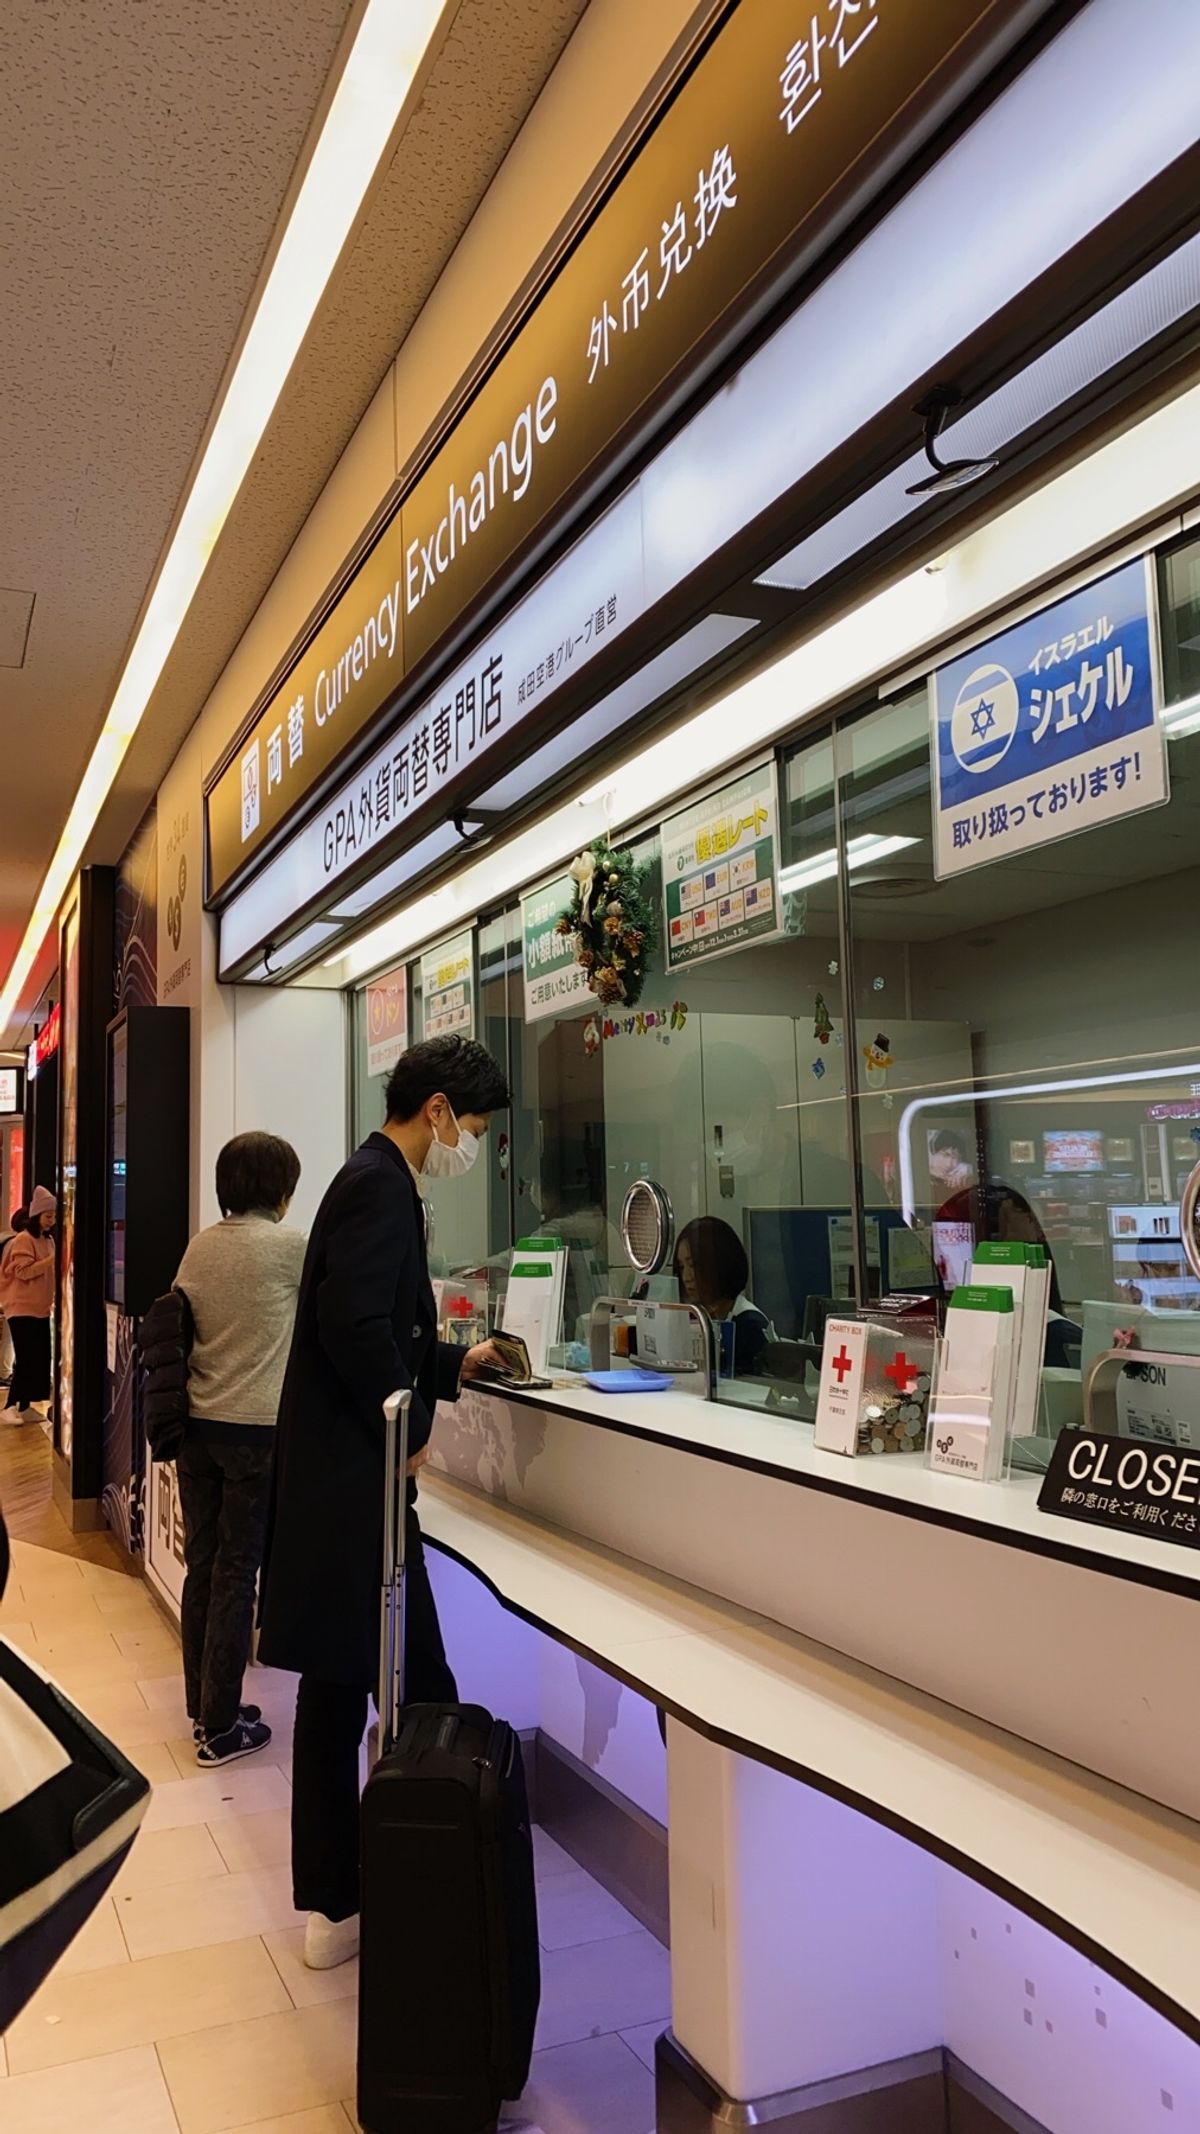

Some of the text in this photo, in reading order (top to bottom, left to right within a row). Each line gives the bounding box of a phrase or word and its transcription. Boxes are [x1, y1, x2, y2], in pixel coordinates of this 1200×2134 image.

[267, 695, 304, 795] 両替
[314, 580, 399, 727] Currency
[407, 376, 557, 615] Exchange
[586, 144, 737, 384] 外币兑换
[516, 593, 618, 705] 成田空港グループ直営
[1028, 615, 1115, 676] イスラエル
[829, 1323, 862, 1336] CHARITY BOX
[1068, 1440, 1200, 1505] CLOSE
